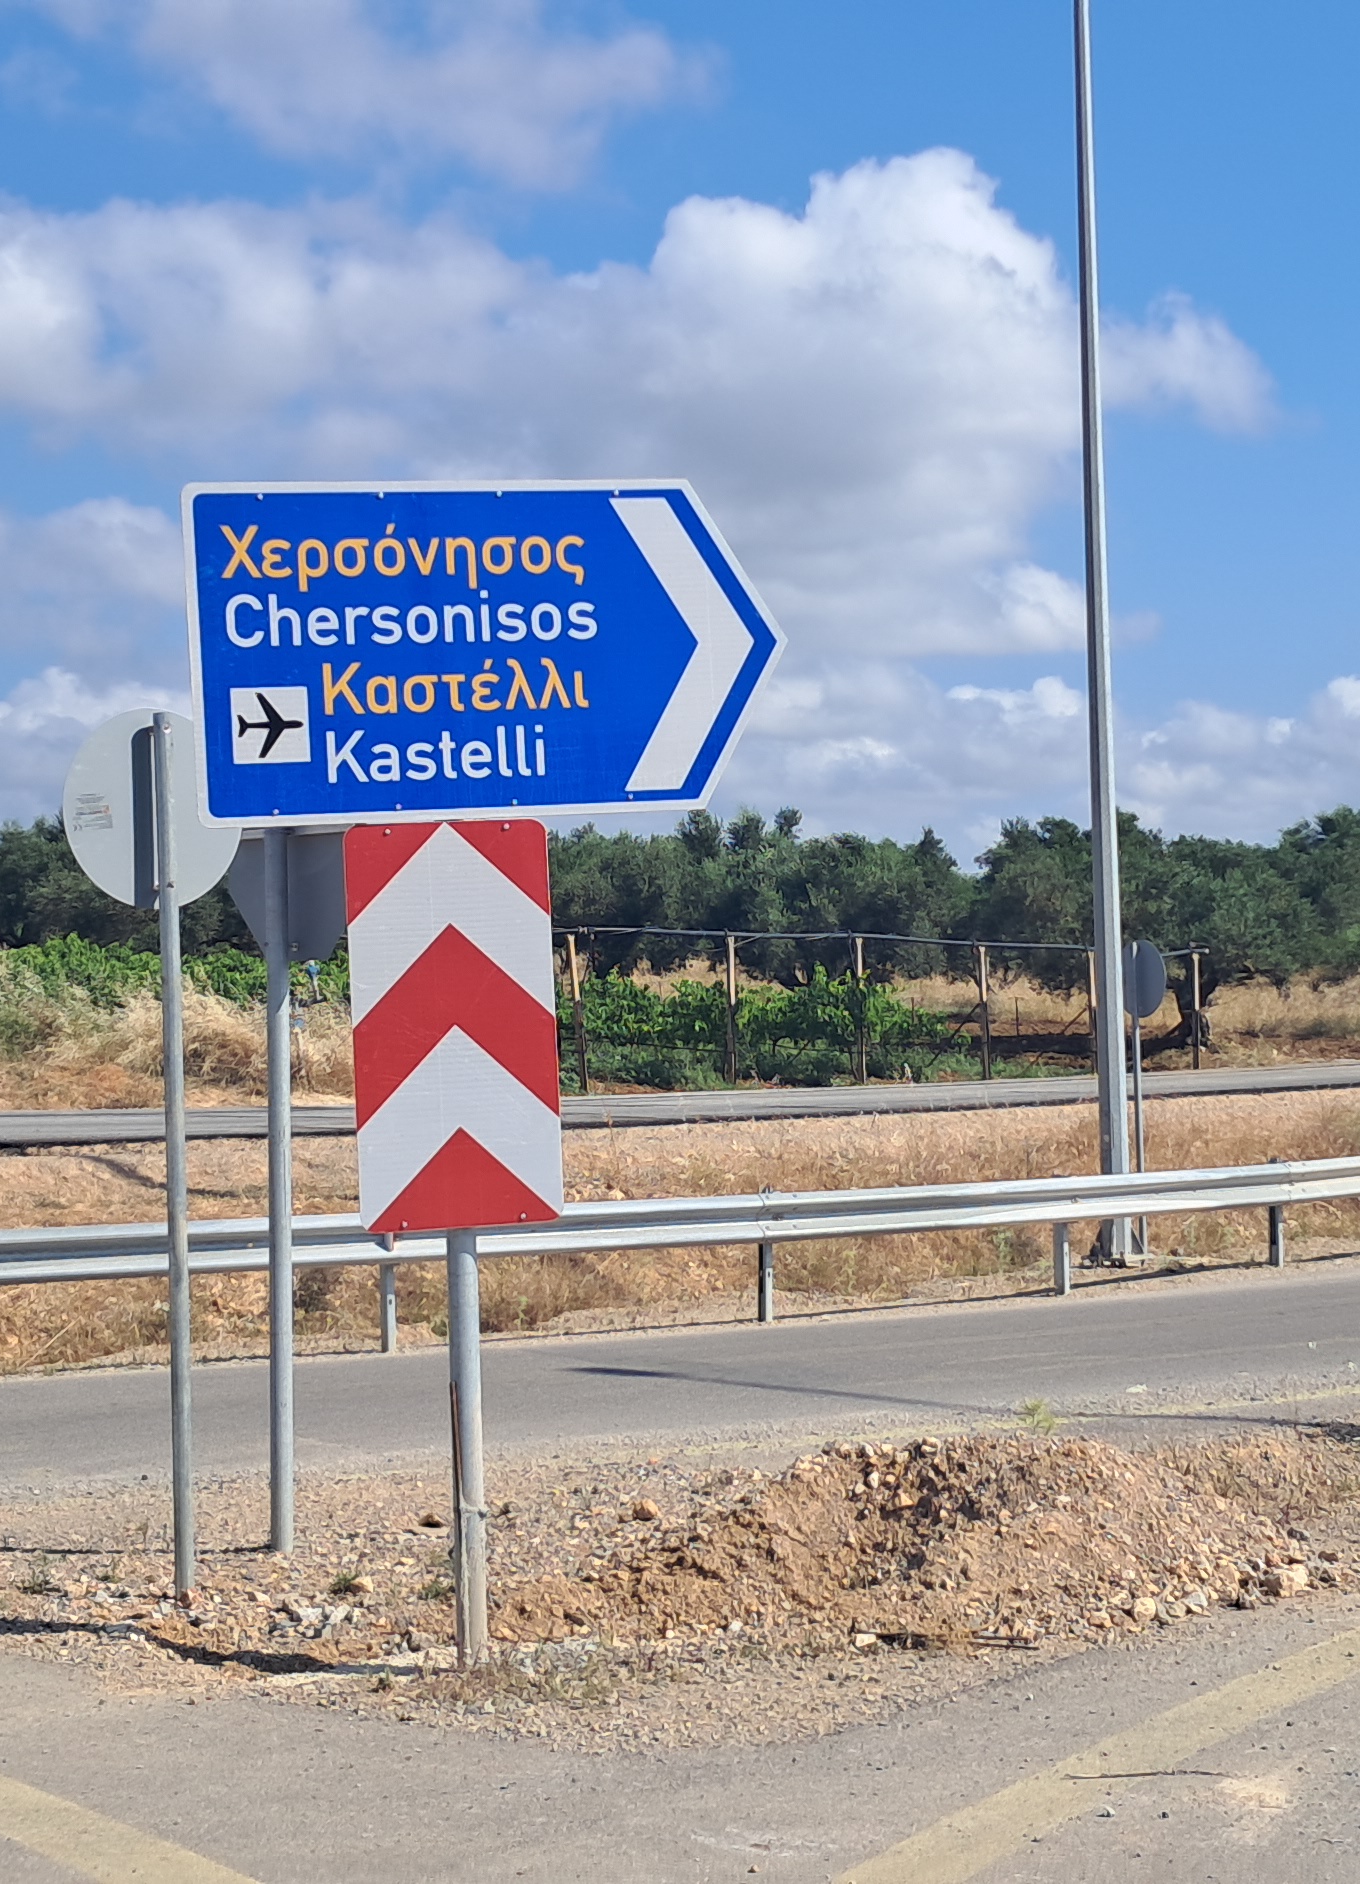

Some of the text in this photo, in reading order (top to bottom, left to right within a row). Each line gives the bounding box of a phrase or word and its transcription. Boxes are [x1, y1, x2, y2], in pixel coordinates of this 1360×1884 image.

[220, 524, 585, 592] Χερσόνησος
[225, 590, 598, 648] Chersonisos
[322, 658, 590, 715] Καστέλλι
[325, 724, 546, 784] Kastelli
